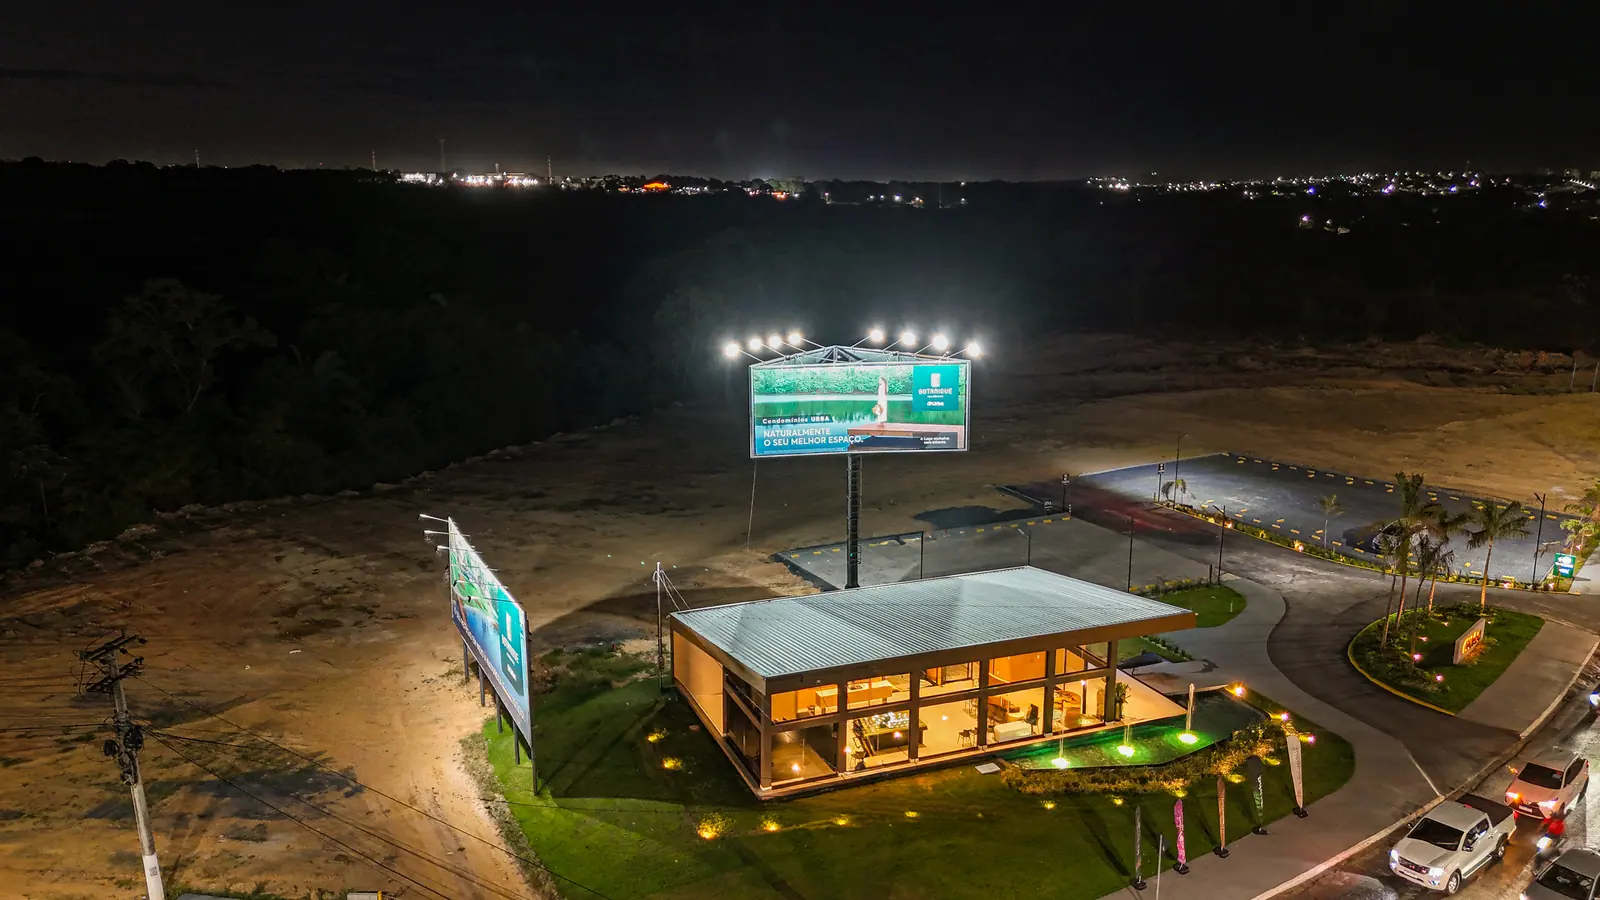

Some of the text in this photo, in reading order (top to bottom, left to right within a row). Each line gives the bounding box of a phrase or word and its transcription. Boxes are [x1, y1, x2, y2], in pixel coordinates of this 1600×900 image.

[763, 428, 831, 438] NATURALMENTE
[773, 438, 789, 446] SEU
[791, 436, 826, 445] MELHOR
[829, 435, 864, 444] ESPAÇO.
